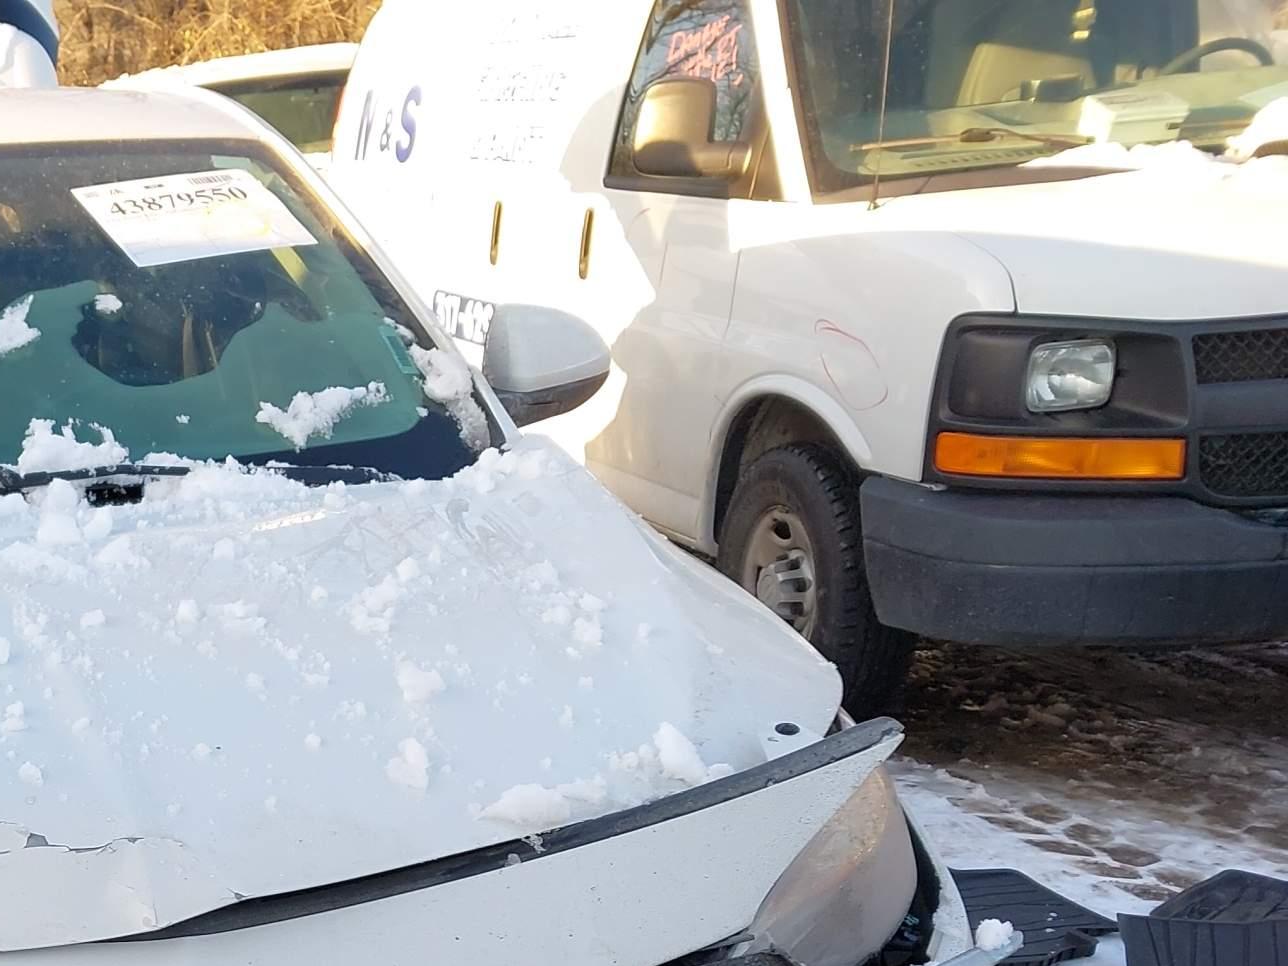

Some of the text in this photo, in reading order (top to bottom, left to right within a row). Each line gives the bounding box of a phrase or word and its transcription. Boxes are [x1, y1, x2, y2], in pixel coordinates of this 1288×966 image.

[380, 108, 393, 152] &
[395, 85, 422, 164] S
[110, 186, 248, 216] 43879550
